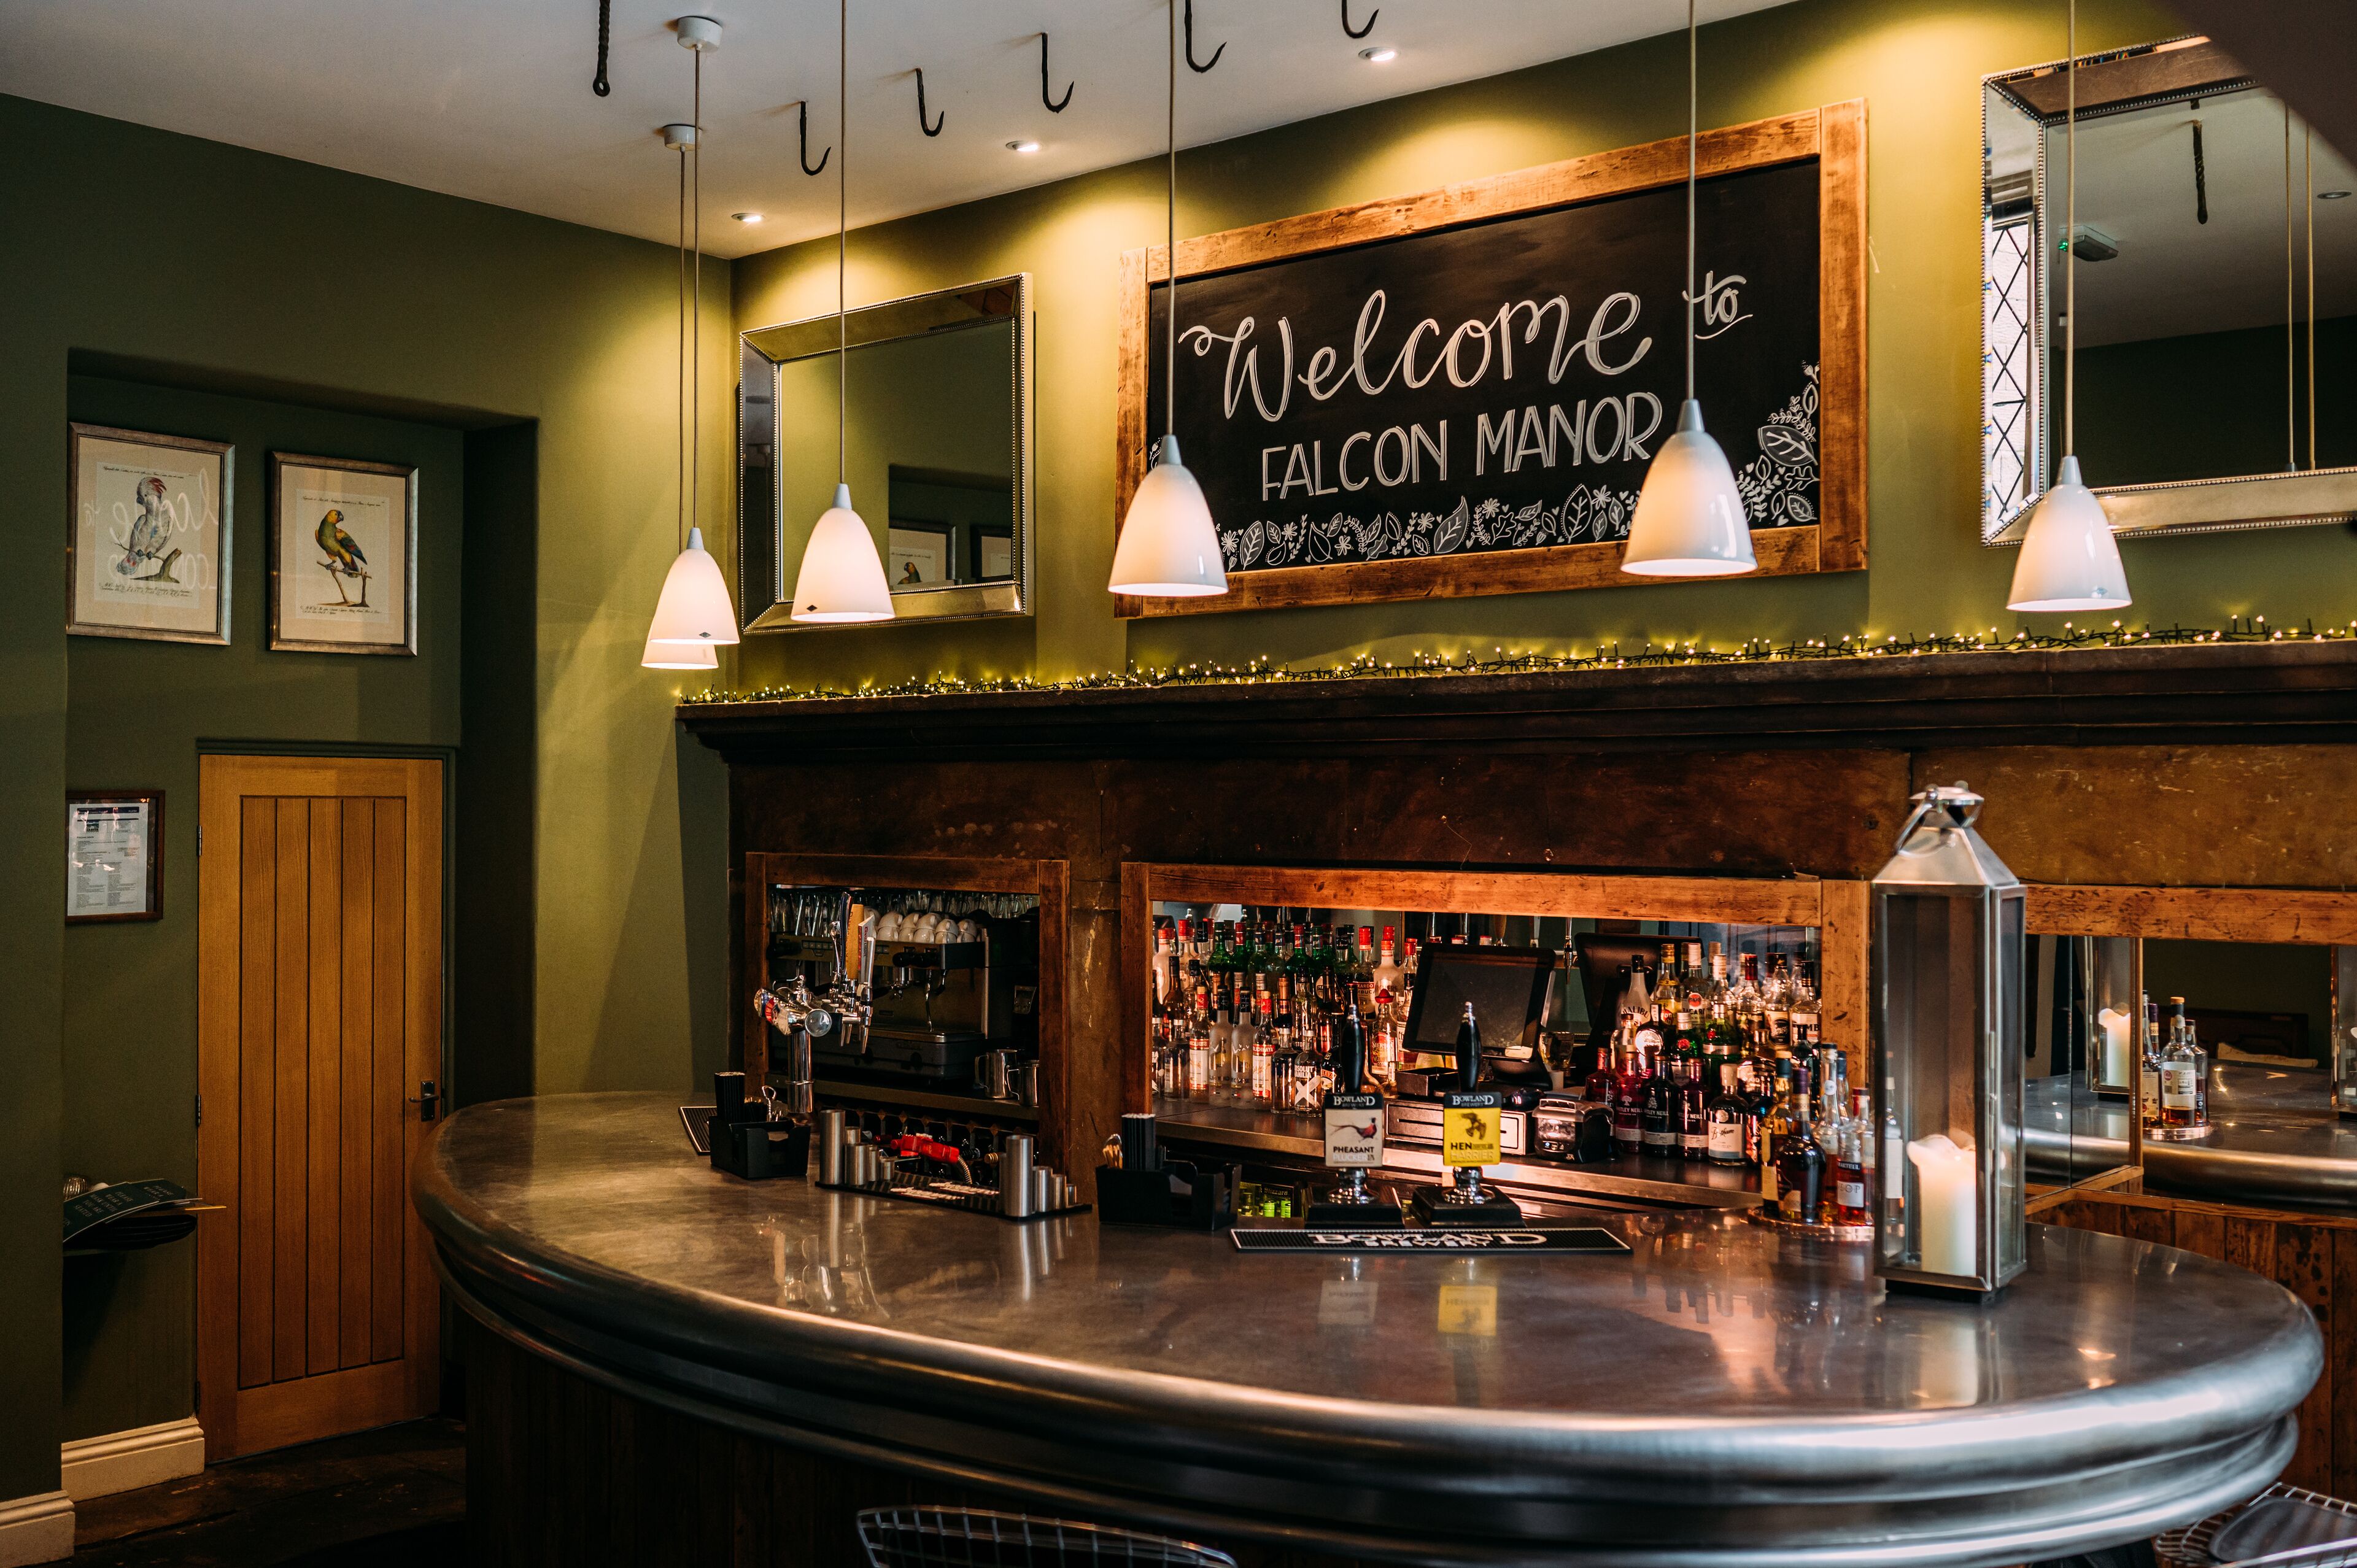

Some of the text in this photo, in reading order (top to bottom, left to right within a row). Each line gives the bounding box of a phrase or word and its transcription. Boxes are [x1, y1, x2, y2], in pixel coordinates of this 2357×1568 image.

[1178, 270, 1754, 423] Welcome to
[1261, 391, 1663, 501] FALCON MANOR
[1333, 1095, 1376, 1106] BOWLAND
[1452, 1095, 1494, 1105] BOWLAND
[1450, 1150, 1494, 1161] HARRIER
[1307, 1233, 1547, 1245] BOWLAND
